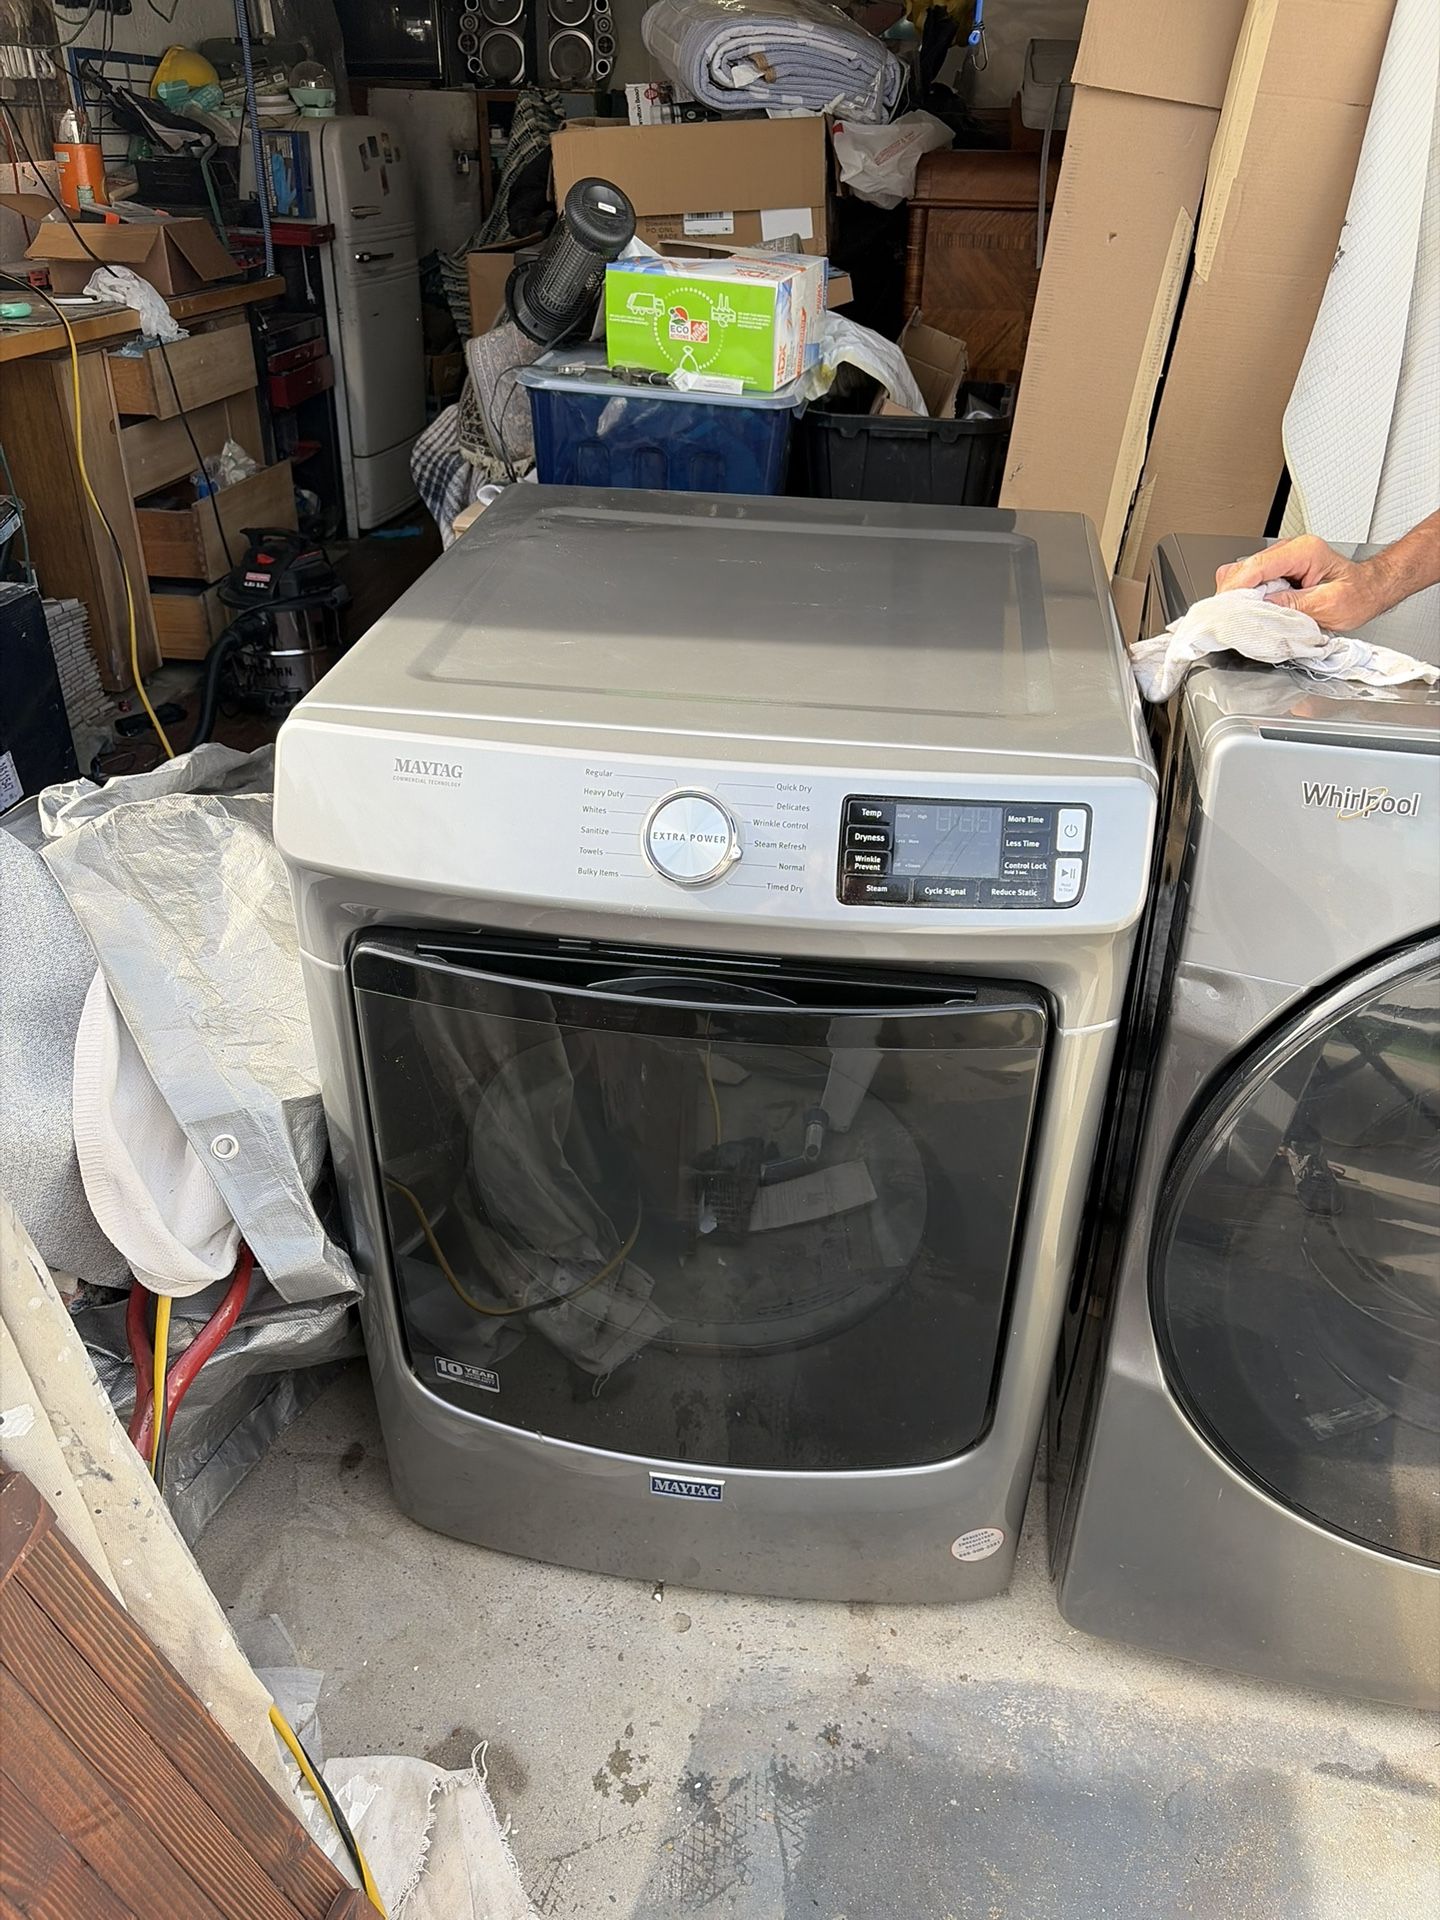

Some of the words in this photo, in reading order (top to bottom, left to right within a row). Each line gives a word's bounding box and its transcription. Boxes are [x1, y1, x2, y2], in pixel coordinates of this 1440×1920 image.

[670, 324, 689, 334] ECO
[394, 758, 463, 778] MAYTAG
[585, 768, 613, 778] Regular
[392, 775, 427, 784] COMMERCIAL
[428, 779, 461, 788] TECHNOLOGY
[584, 787, 605, 798] Heavy
[606, 789, 624, 799] Duty
[776, 782, 795, 792] Quick
[796, 784, 812, 794] Dry
[1302, 782, 1420, 818] Whirlpool
[582, 805, 607, 815] Whites
[776, 802, 810, 812] Delicates
[862, 808, 882, 818] Temp
[752, 819, 780, 829] Wrinkle
[782, 820, 809, 830] Control
[580, 826, 610, 836] Sanitize
[652, 831, 686, 842] EXTRA
[690, 833, 726, 844] POWER
[854, 832, 885, 842] Dryness
[754, 840, 777, 849] Steam
[778, 841, 807, 851] Refresh
[579, 846, 604, 856] Towels
[854, 855, 882, 863] Wrinkle
[778, 863, 805, 872] Normal
[854, 863, 881, 871] Prevent
[577, 867, 597, 878] Bulky
[598, 869, 619, 878] Items
[766, 882, 789, 892] Timed
[790, 884, 804, 893] Dry
[924, 887, 942, 895] Cycle
[944, 887, 967, 896] Signal
[438, 1359, 463, 1376] 10
[464, 1366, 495, 1379] YEAR
[654, 1479, 720, 1497] MAYTAG
